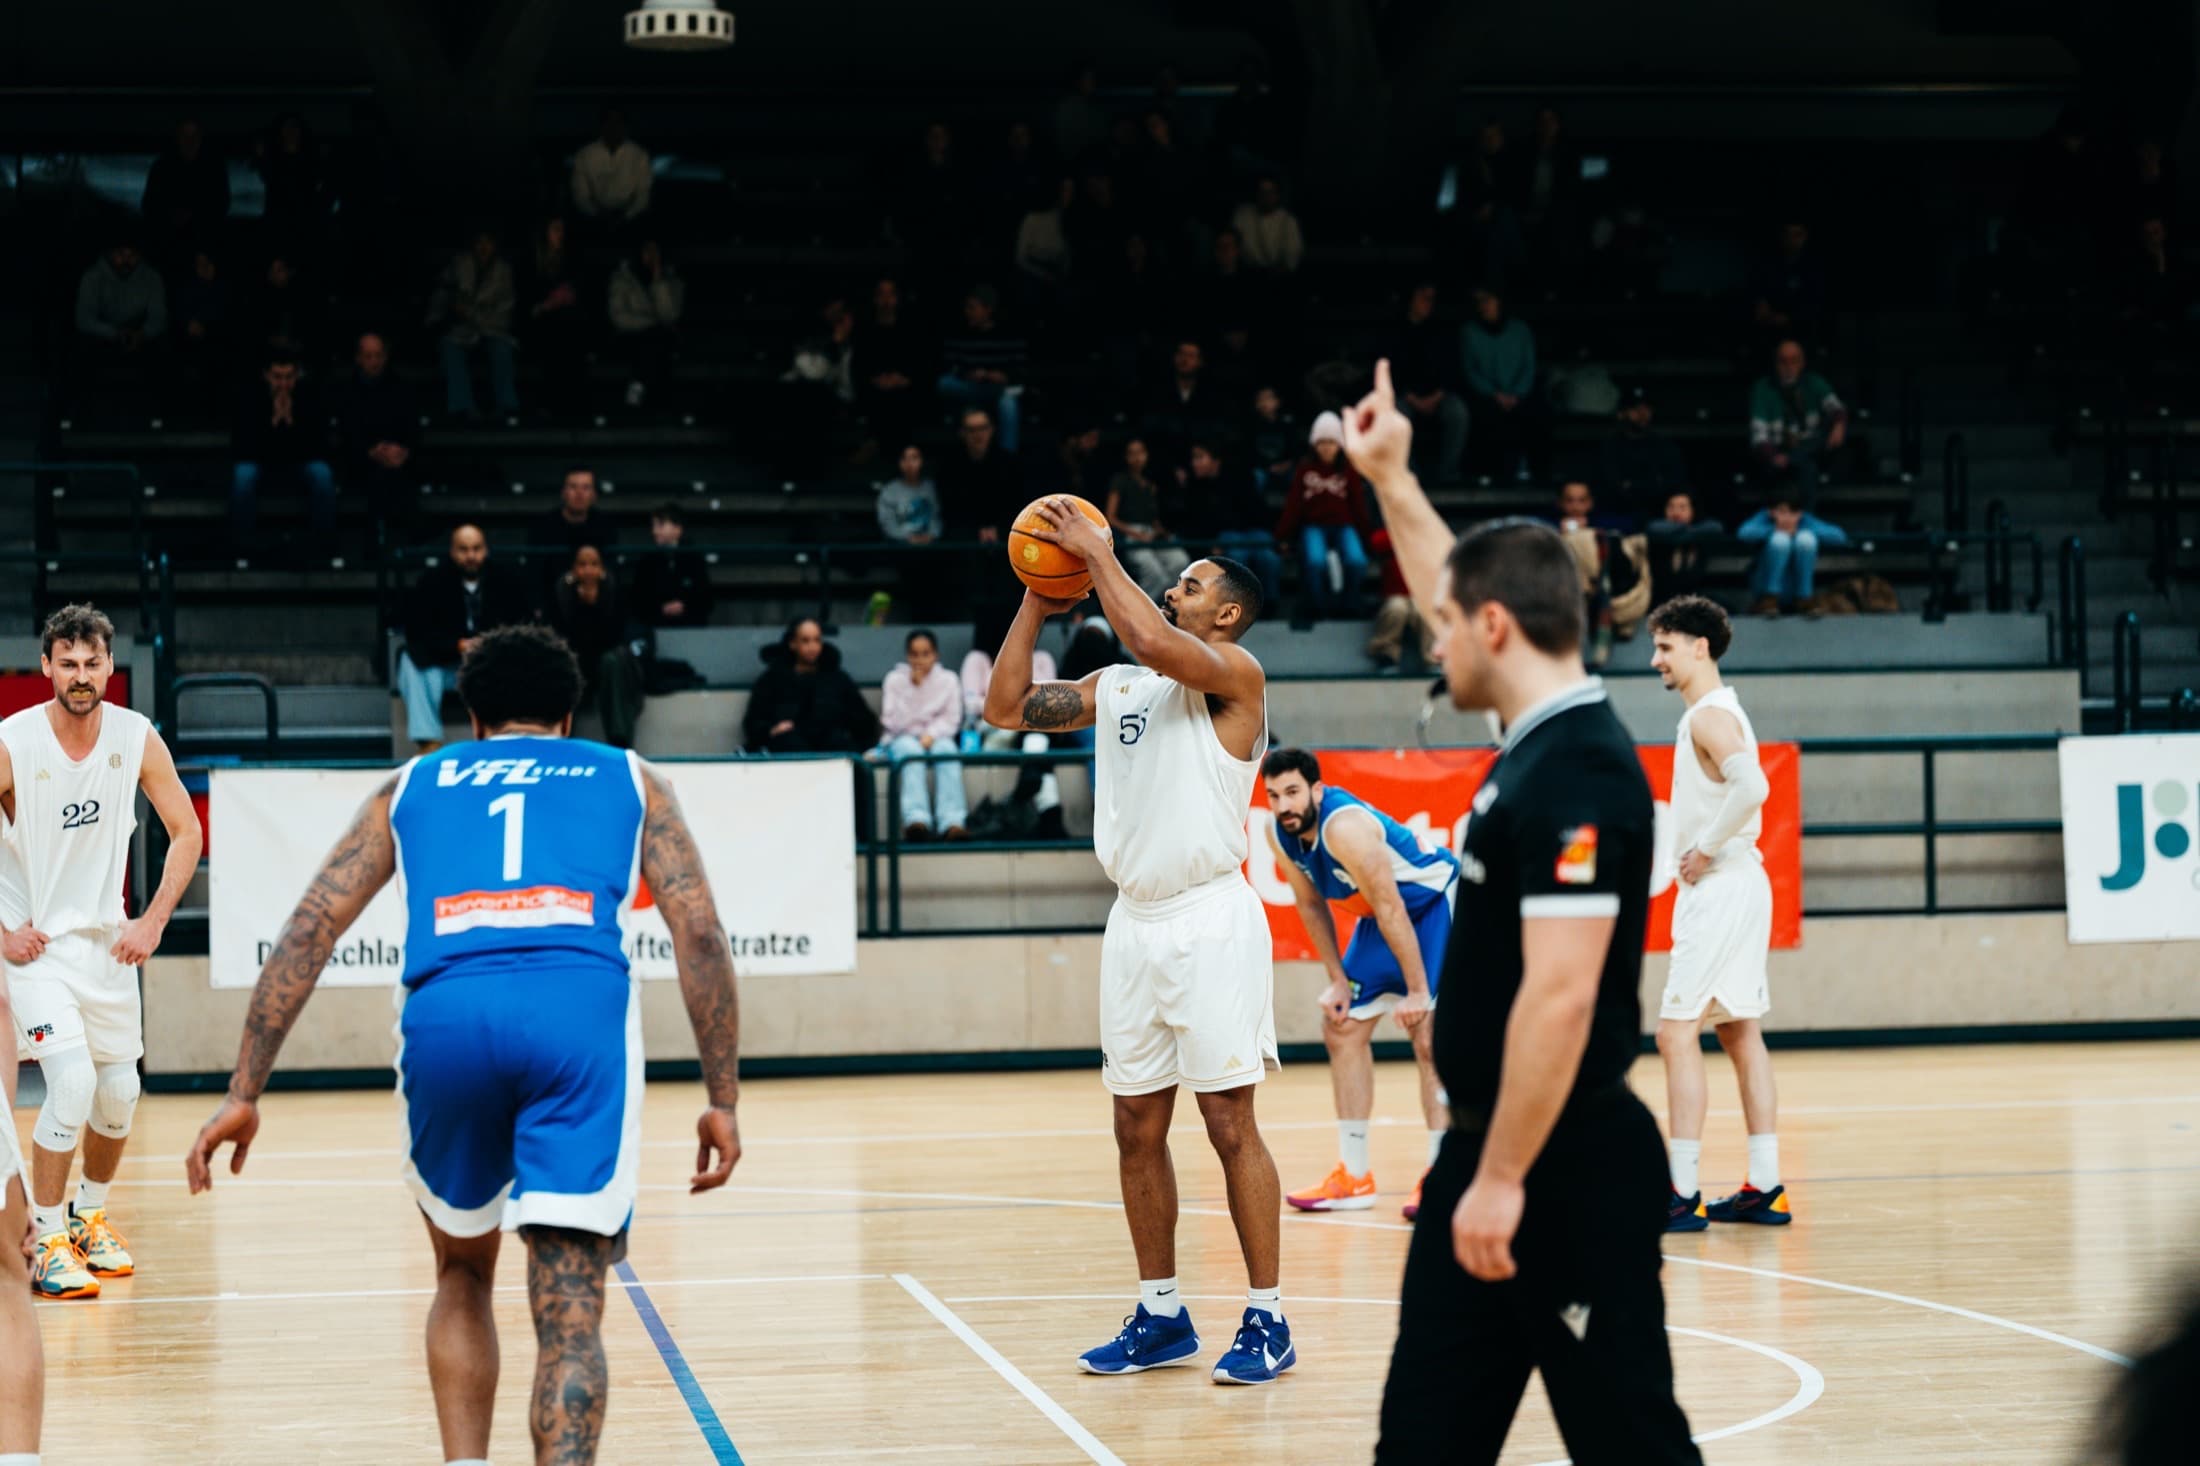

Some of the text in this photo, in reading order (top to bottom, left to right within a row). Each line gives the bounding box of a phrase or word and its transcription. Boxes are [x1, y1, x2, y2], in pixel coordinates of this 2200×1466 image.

[531, 765, 598, 778] STADE
[62, 799, 100, 831] 22
[488, 792, 525, 881] 1
[731, 931, 811, 958] tratze
